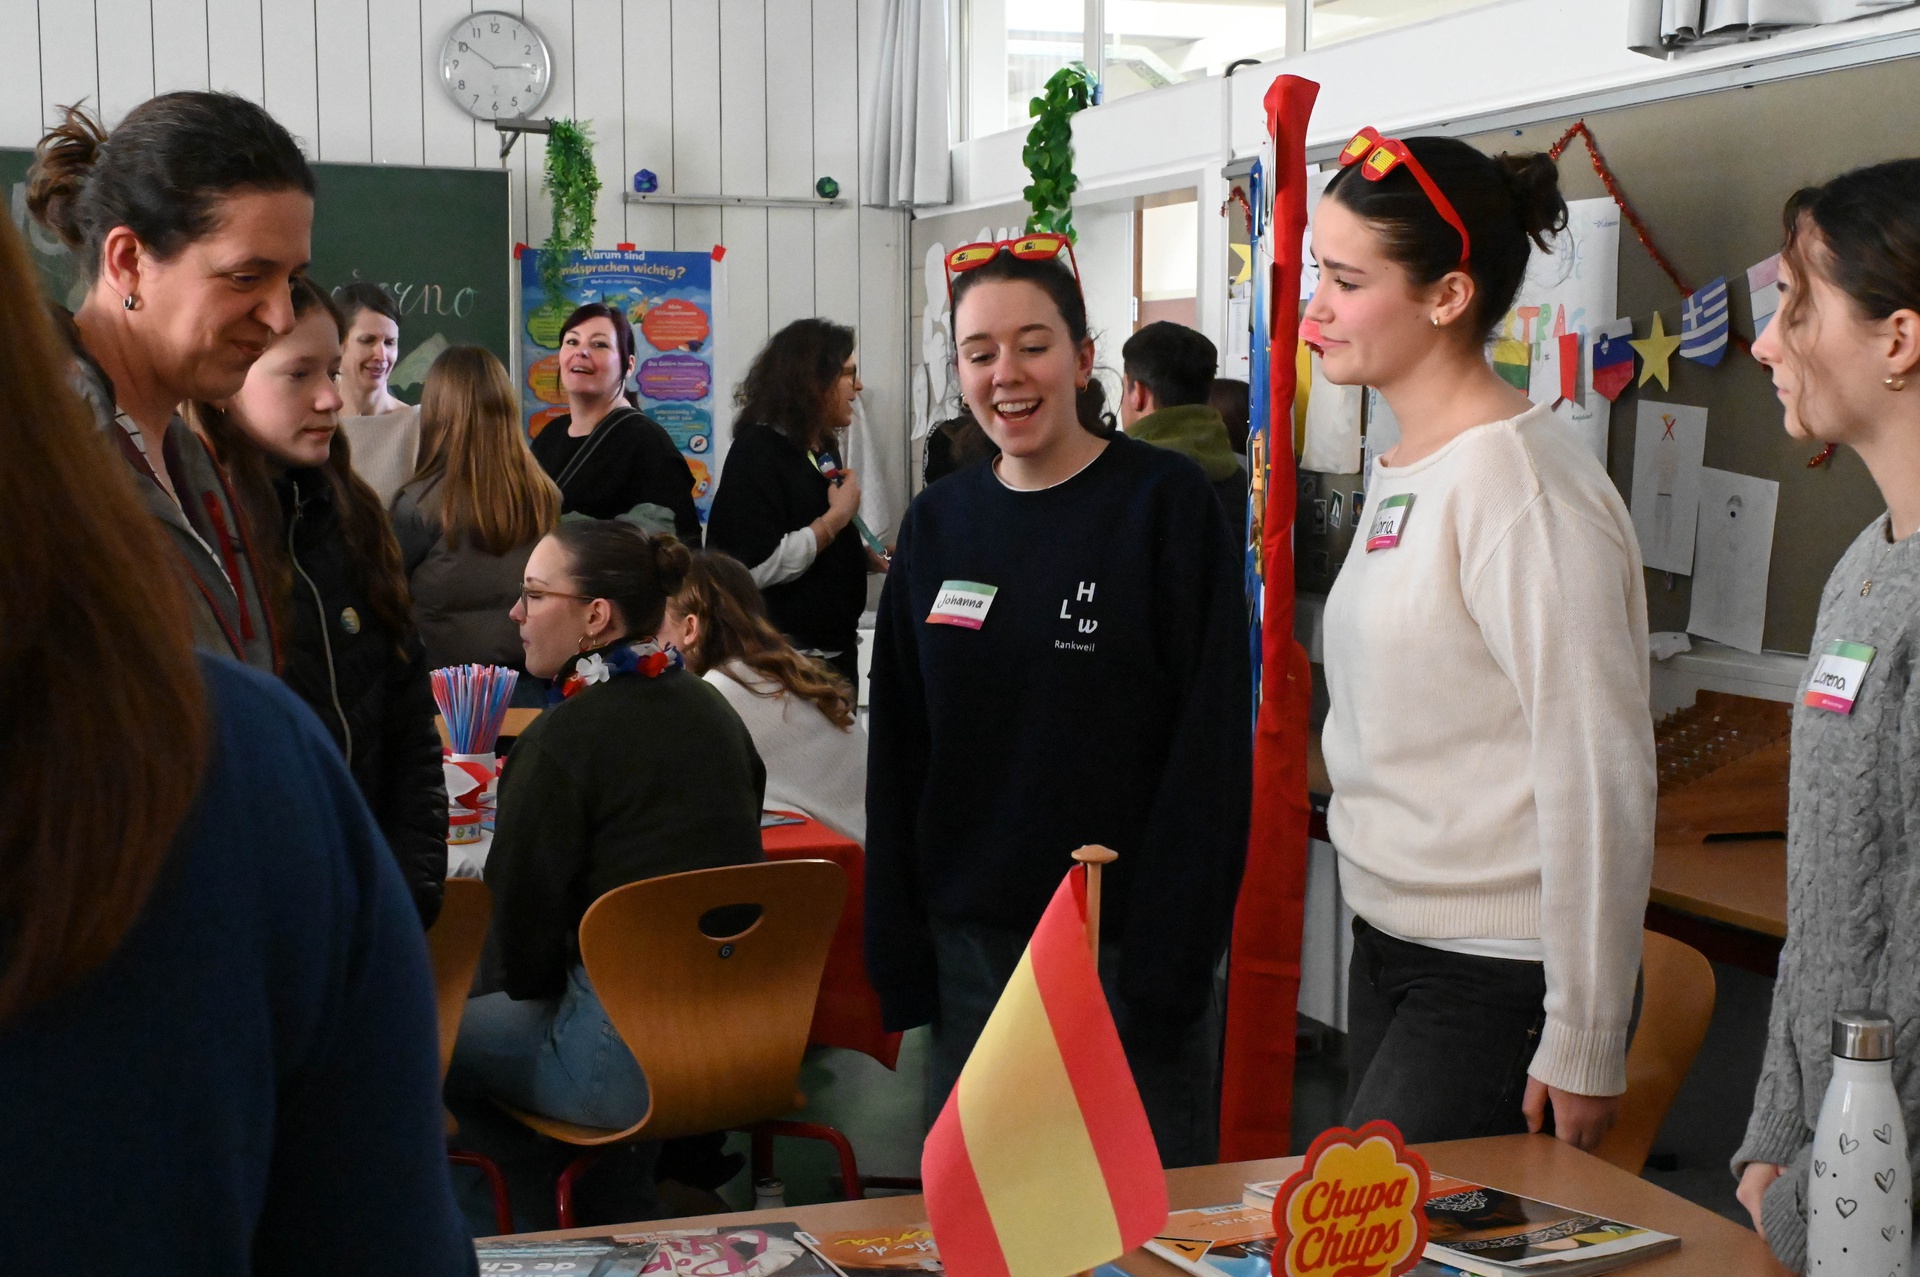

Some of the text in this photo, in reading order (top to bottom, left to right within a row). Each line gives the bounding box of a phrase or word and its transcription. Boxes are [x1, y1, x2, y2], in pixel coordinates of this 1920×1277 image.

[472, 28, 481, 39] 11
[490, 23, 500, 34] 12
[512, 30, 516, 41] 1
[458, 41, 469, 53] 10
[524, 45, 532, 55] 2
[452, 60, 459, 70] 9
[458, 80, 466, 90] 8
[525, 85, 532, 93] 4
[473, 94, 479, 104] 7
[511, 96, 518, 107] 5
[492, 101, 499, 111] 6
[624, 250, 645, 260] sind
[560, 261, 686, 281] mdsprachen wichtig?
[1076, 581, 1096, 602] H
[937, 594, 983, 609] Johanna
[1059, 599, 1072, 619] L
[1054, 640, 1095, 652] Rankweil
[1813, 660, 1846, 691] Lorena
[1302, 1177, 1409, 1227] Chupa
[1295, 1219, 1402, 1273] Chups
[533, 1262, 576, 1272] de
